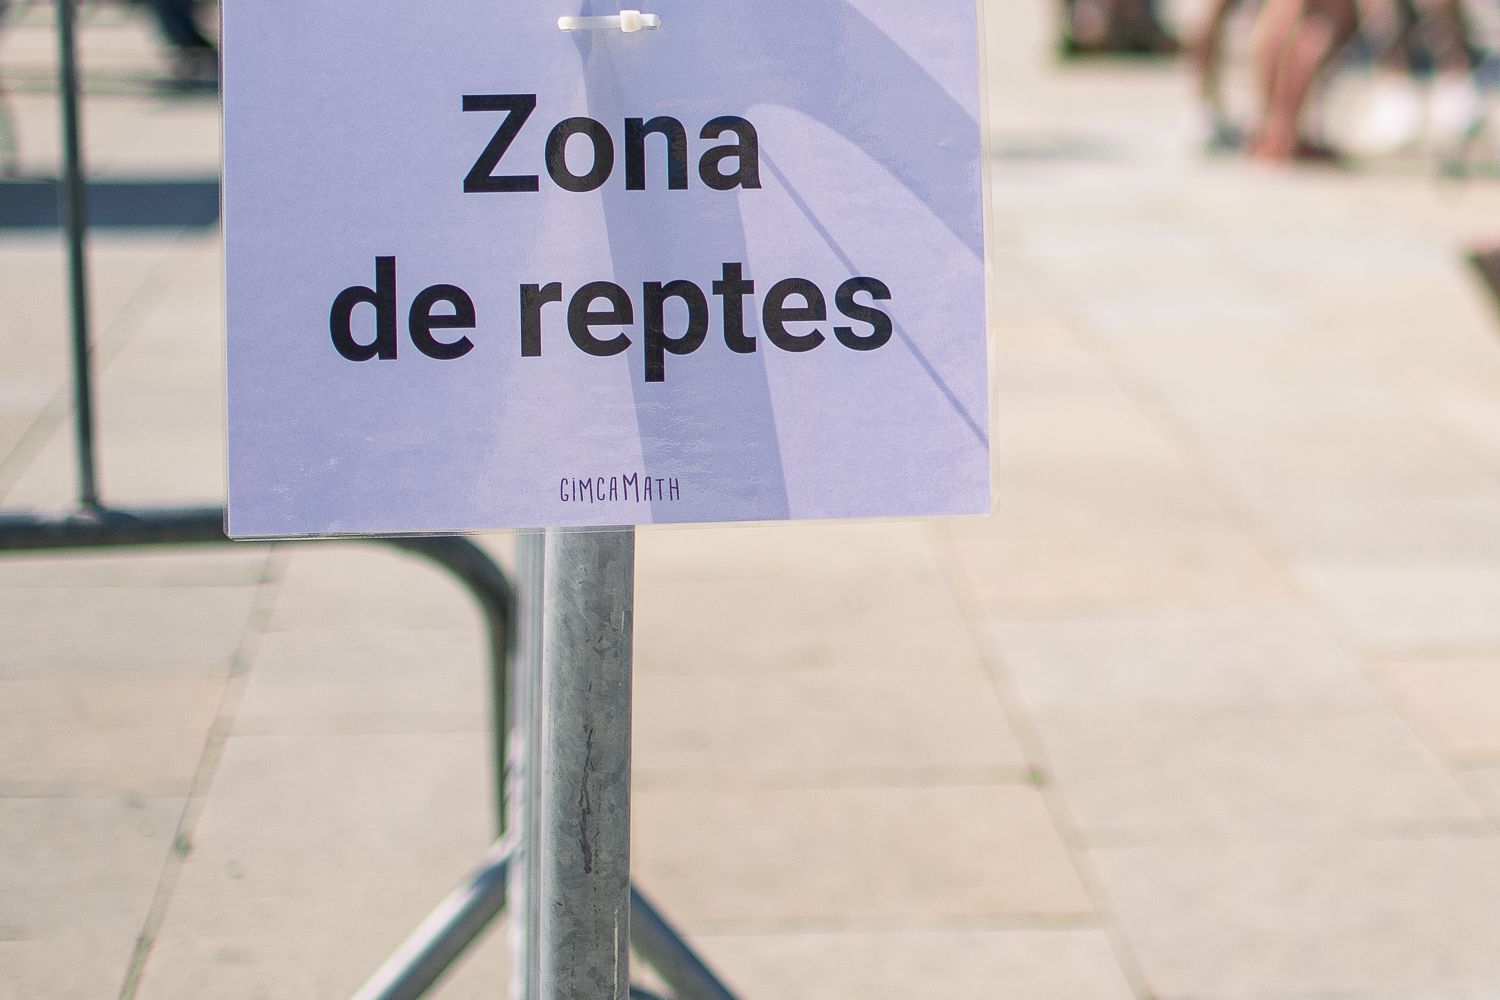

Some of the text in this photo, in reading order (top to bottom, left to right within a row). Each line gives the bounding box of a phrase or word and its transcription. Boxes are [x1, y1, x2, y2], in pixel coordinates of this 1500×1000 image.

[462, 93, 762, 194] Zona
[329, 255, 893, 383] de reptes
